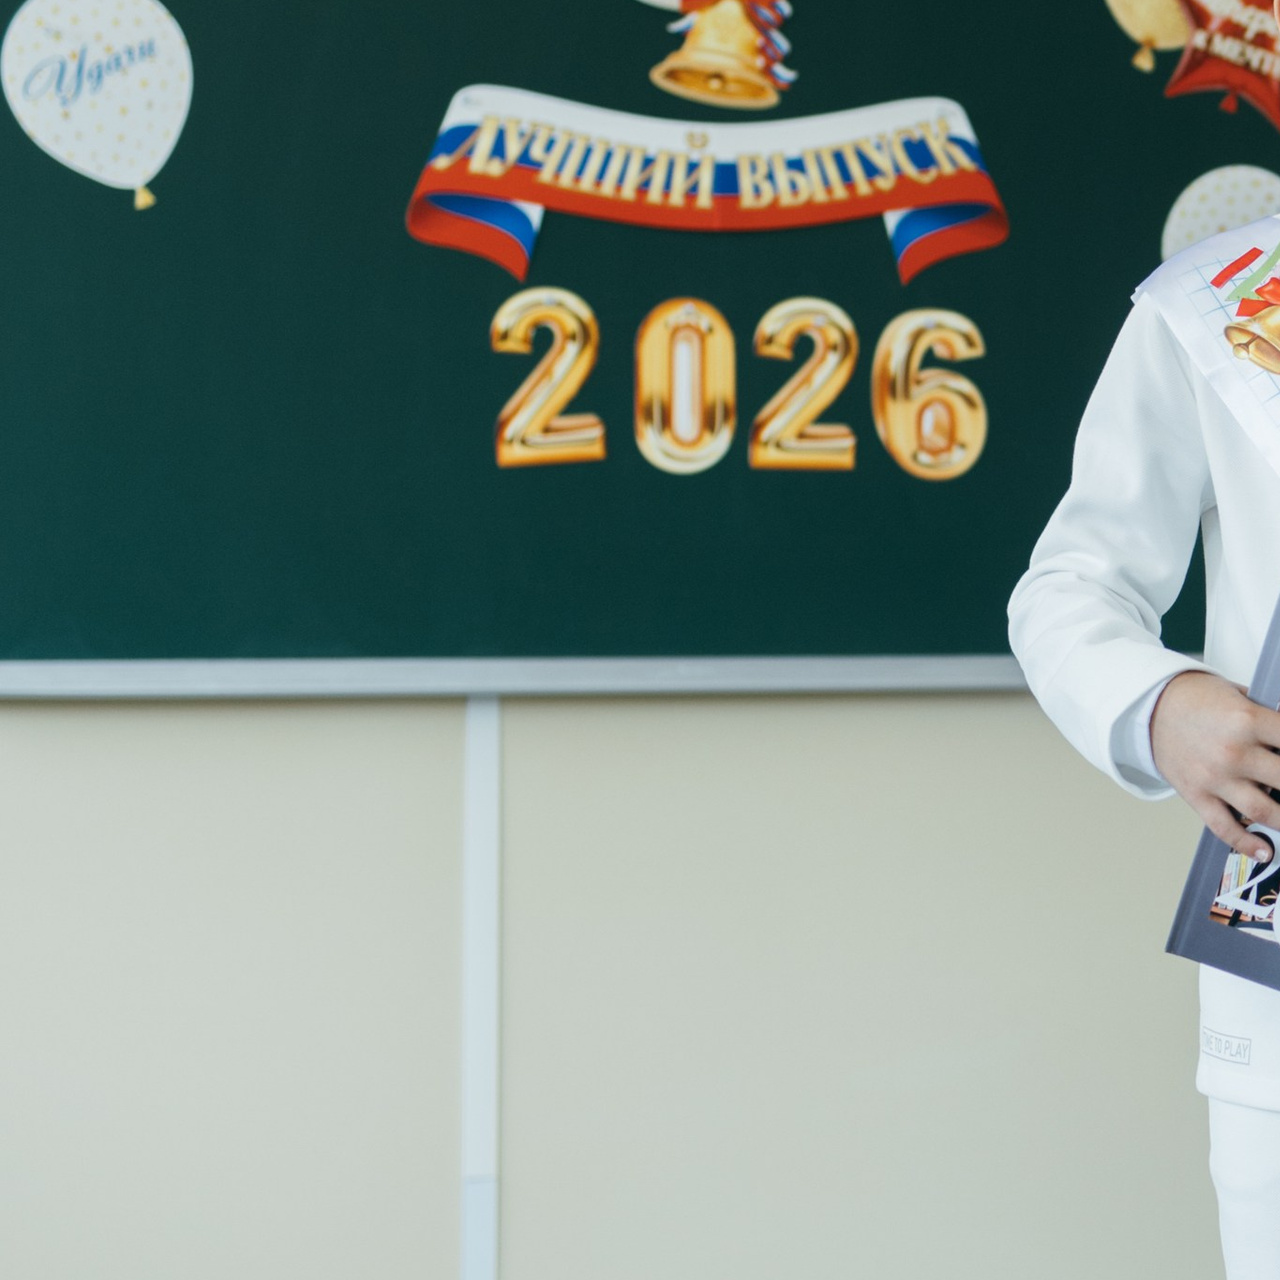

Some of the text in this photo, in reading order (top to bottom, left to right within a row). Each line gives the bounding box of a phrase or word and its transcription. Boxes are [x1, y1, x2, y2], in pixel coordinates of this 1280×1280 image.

[433, 114, 980, 211] ЛУЧШИЙ ВЫПУСК
[489, 286, 989, 480] 2026
[1224, 1039, 1249, 1059] PLAY
